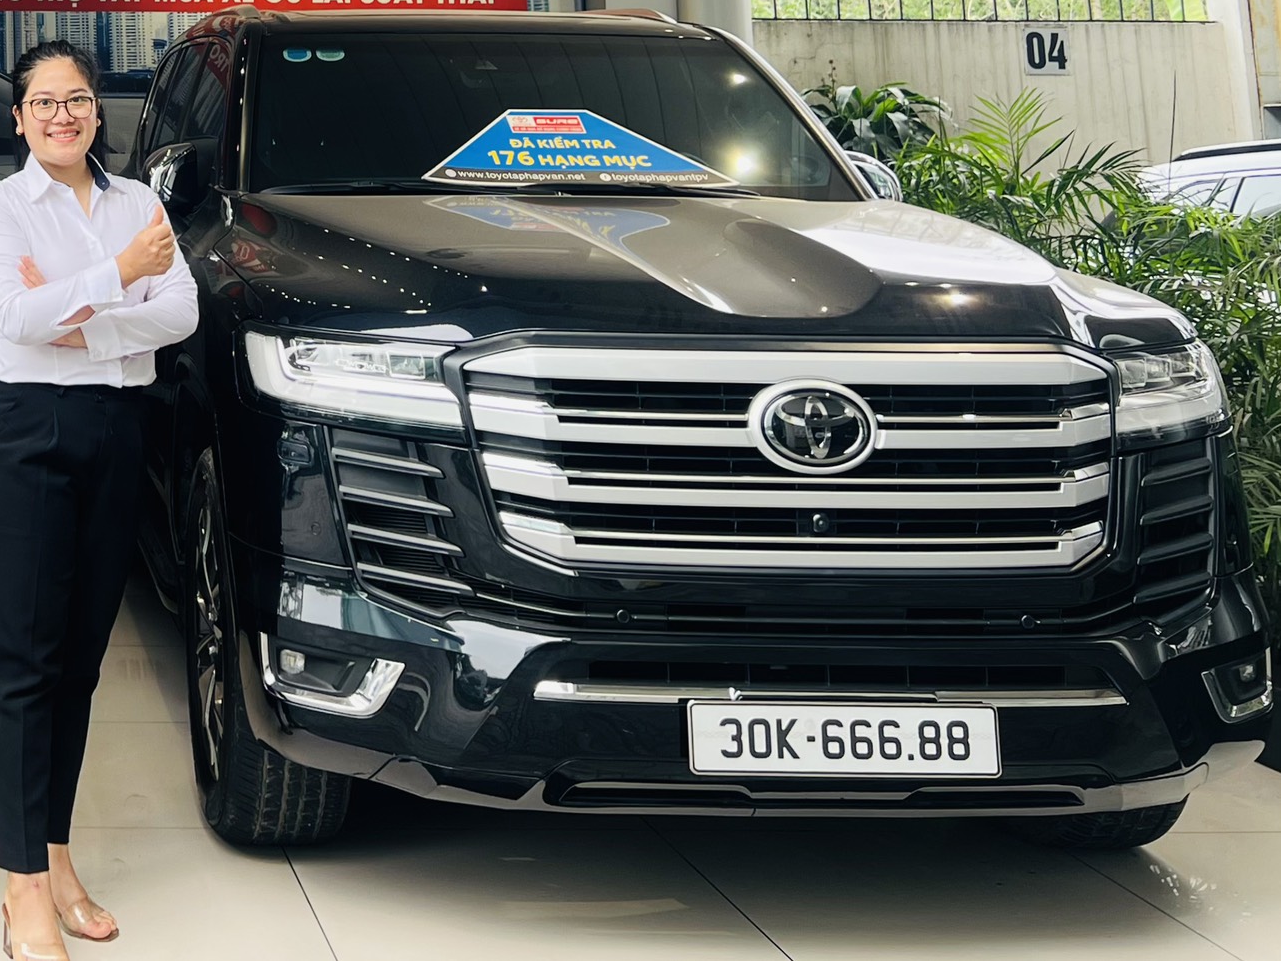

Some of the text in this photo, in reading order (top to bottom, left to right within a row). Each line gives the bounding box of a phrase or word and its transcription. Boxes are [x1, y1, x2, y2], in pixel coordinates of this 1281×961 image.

[1026, 32, 1067, 69] 04
[509, 137, 536, 149] ĐÃ
[581, 139, 616, 149] TRA
[487, 150, 653, 170] 176 HẠNG MỤC
[458, 170, 586, 181] www.toyotaphapvan.net
[719, 718, 970, 761] 30K-666.88
